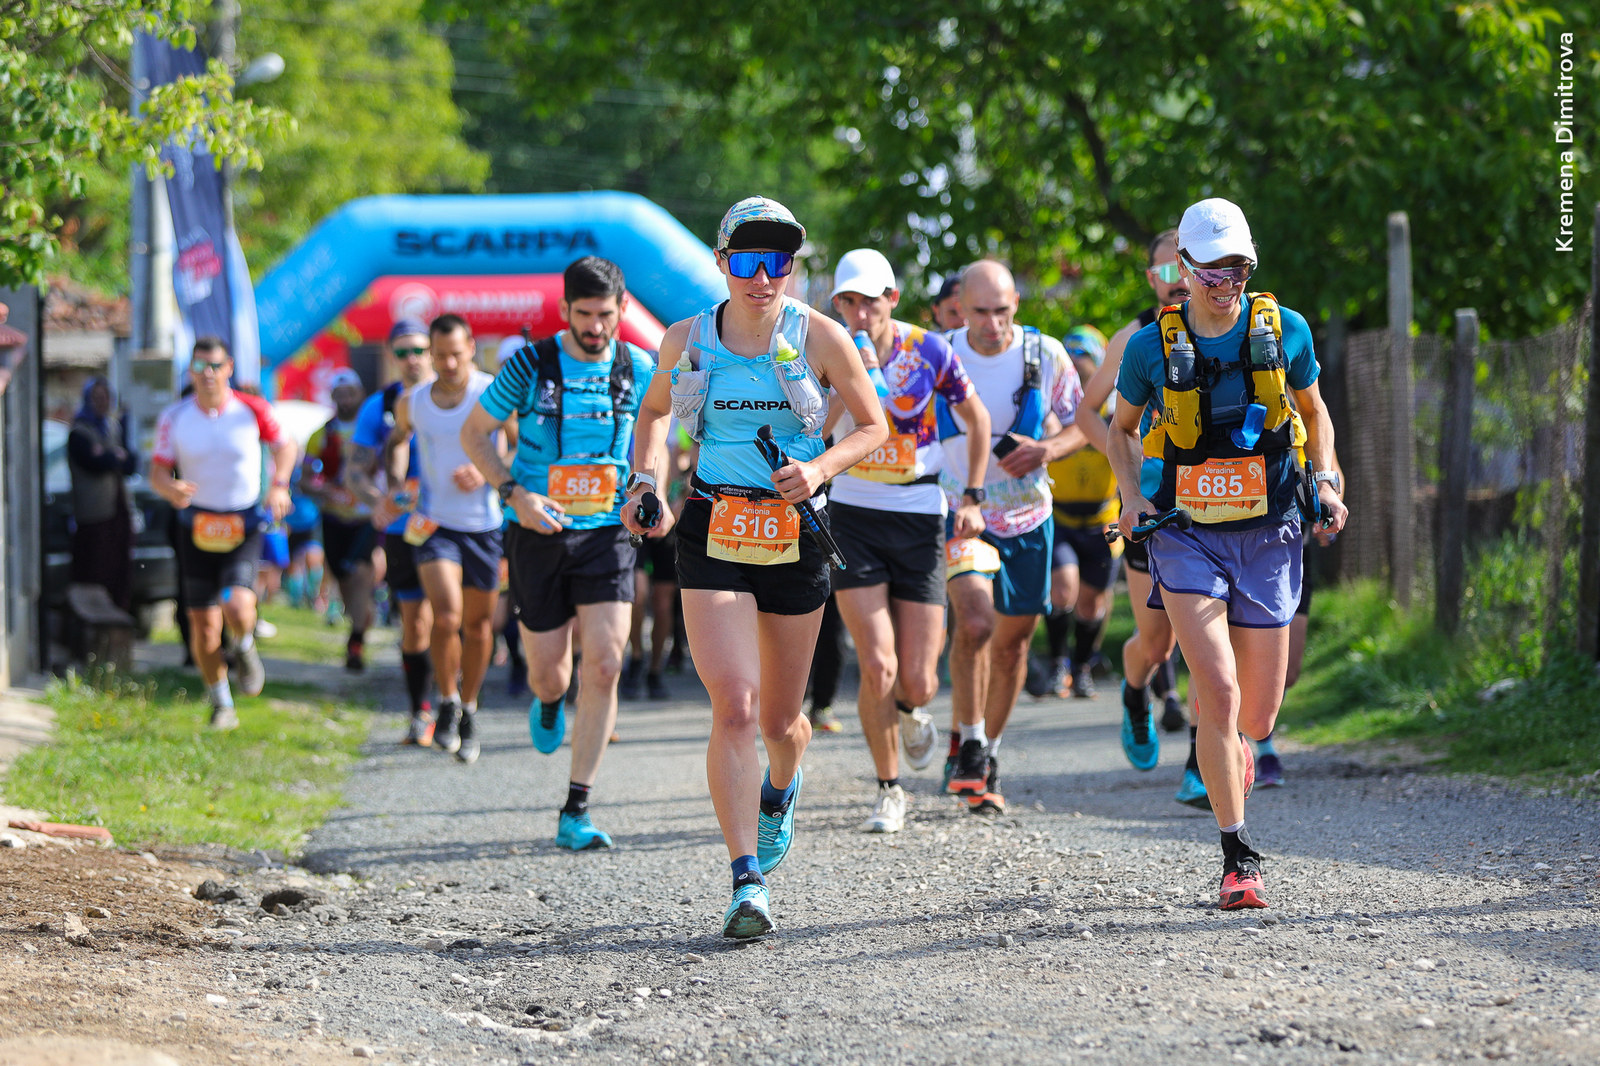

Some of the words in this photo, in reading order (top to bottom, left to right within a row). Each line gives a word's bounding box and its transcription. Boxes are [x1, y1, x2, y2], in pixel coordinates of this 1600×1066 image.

[395, 228, 601, 257] SCARPA
[713, 400, 792, 411] SCARPA
[1204, 466, 1235, 475] Veradina
[566, 477, 602, 496] 582
[1197, 474, 1244, 497] 685
[731, 513, 779, 539] 516
